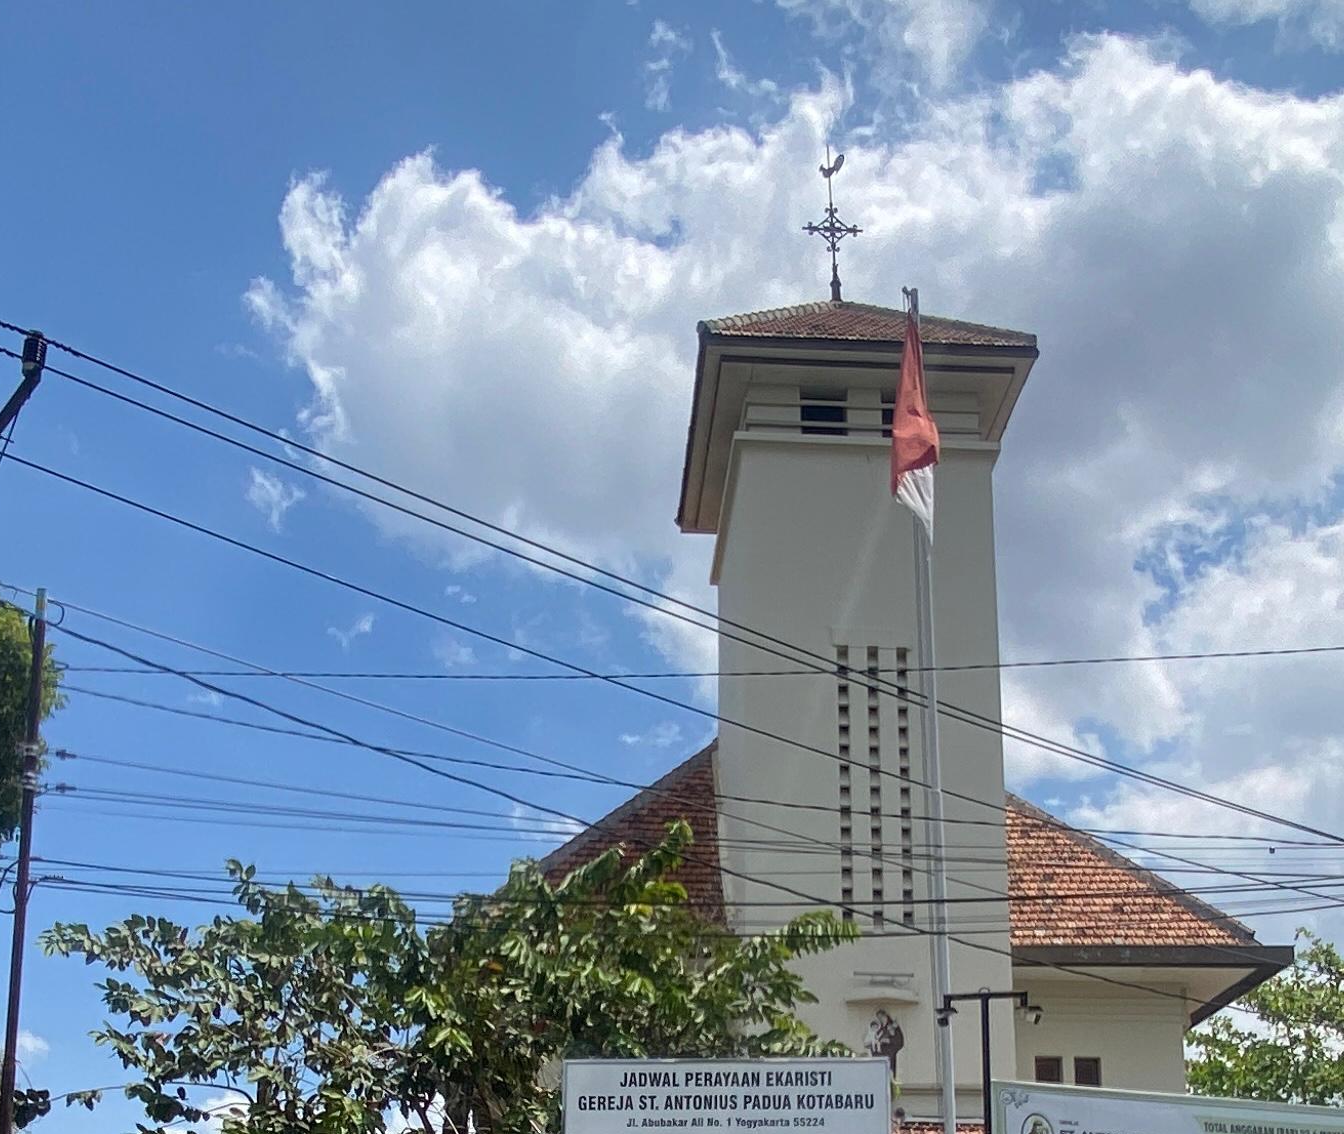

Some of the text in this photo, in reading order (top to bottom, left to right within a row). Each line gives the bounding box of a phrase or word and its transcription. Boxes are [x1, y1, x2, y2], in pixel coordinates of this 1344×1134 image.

[619, 1071, 832, 1088] JADWAL PERAYAAN EKARISTI
[578, 1093, 875, 1111] GEREJA ST. ANTONIUS PADUA KOTABARU
[641, 1118, 688, 1127] Abubakar
[691, 1118, 704, 1127] Ali
[707, 1118, 722, 1127] No.
[726, 1118, 732, 1127] 1
[735, 1117, 790, 1129] Yogyakarta
[793, 1117, 825, 1127] 55224
[1204, 1121, 1228, 1134] TOTAL
